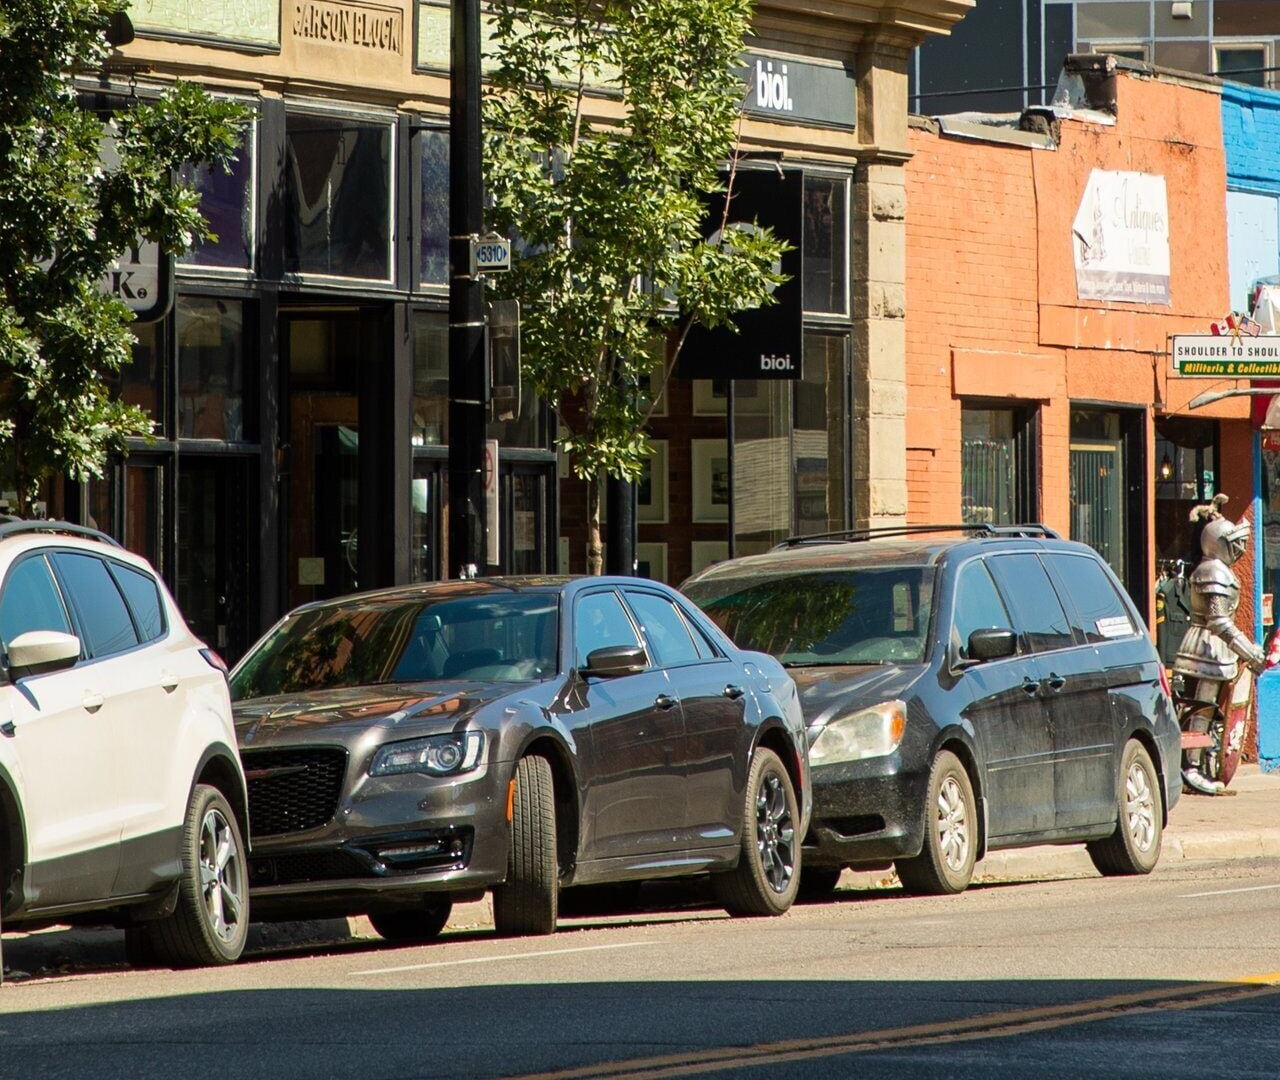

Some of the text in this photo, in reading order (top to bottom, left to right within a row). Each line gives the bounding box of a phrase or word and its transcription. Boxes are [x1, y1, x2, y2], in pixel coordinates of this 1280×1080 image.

[292, 3, 349, 43] CARSON
[352, 10, 401, 52] BLOCK
[756, 59, 793, 111] bioi.
[481, 244, 504, 263] 5310
[1177, 346, 1228, 357] SHOULDER
[1232, 346, 1244, 357] TO
[760, 354, 795, 370] bioi.
